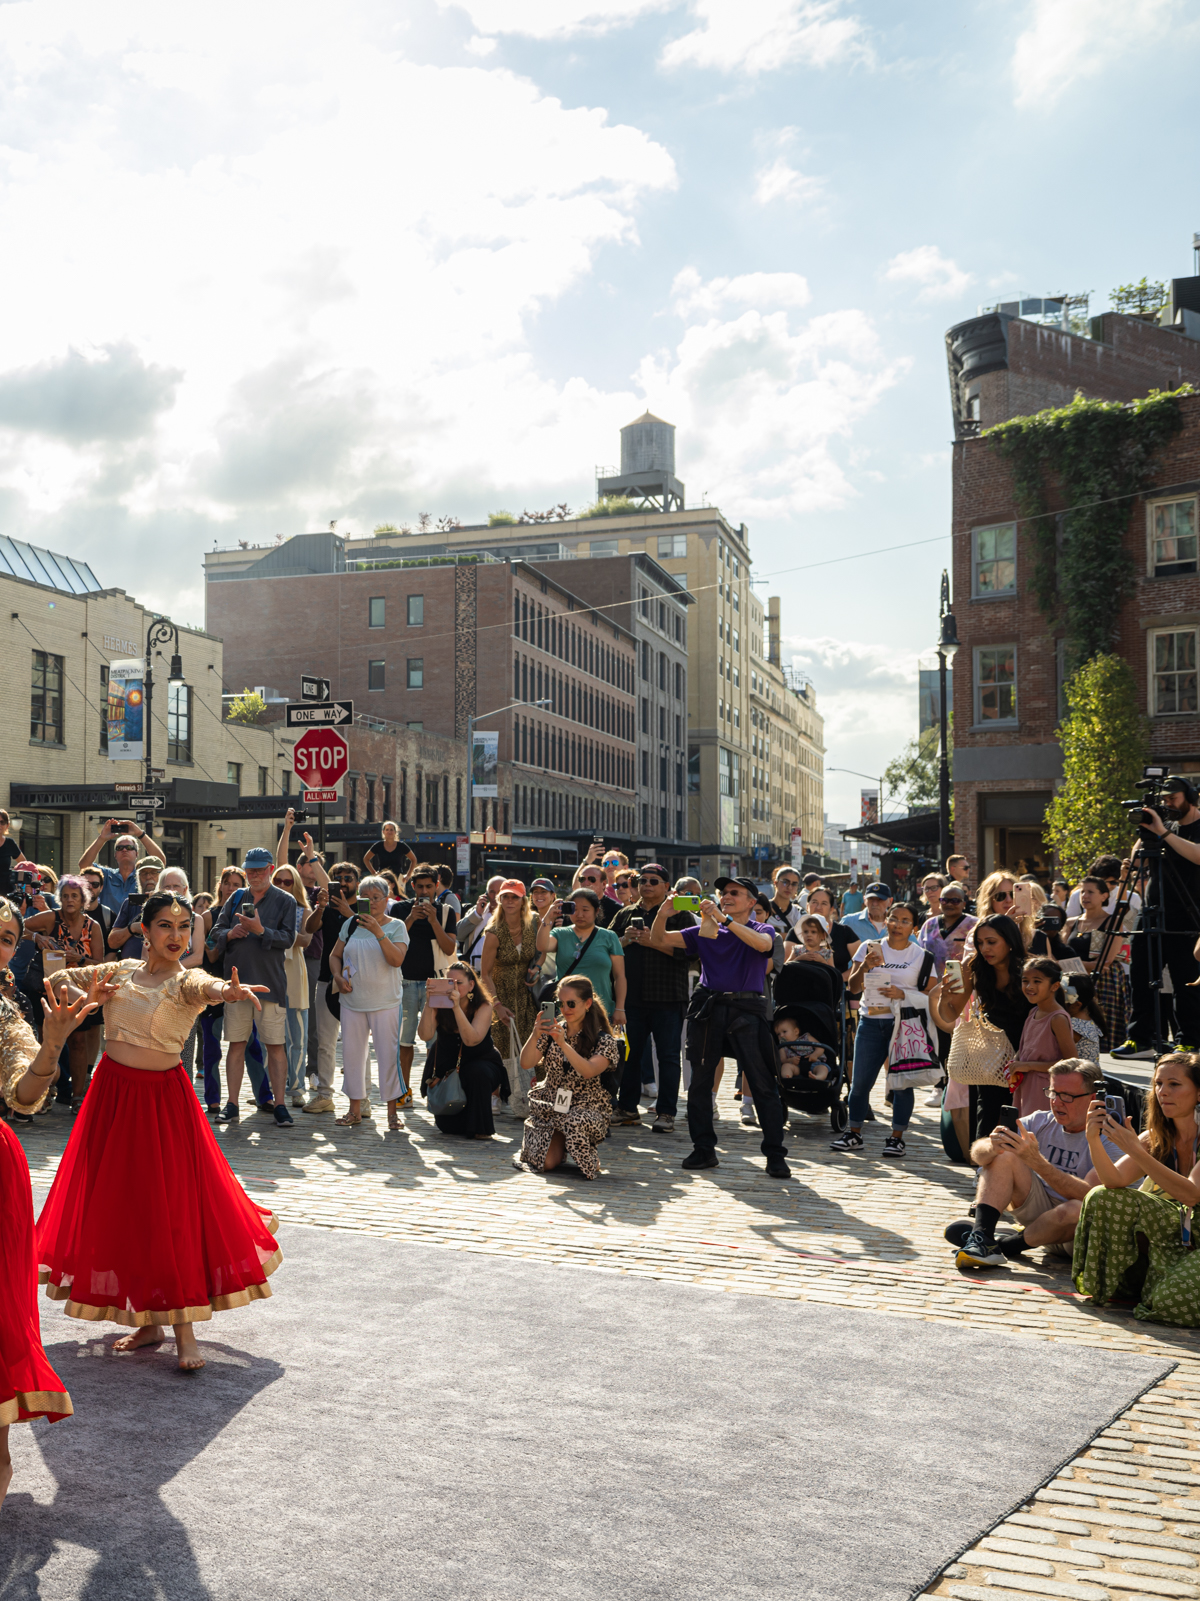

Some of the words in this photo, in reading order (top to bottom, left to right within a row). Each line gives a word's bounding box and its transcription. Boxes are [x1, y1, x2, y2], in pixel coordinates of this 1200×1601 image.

[305, 684, 314, 694] ONE
[295, 711, 315, 720] ONE
[324, 709, 343, 719] WAY
[296, 746, 345, 770] STOP
[116, 784, 136, 792] Greenwich
[307, 792, 319, 800] ALL
[322, 792, 335, 800] WAY
[1047, 1144, 1080, 1170] THE
